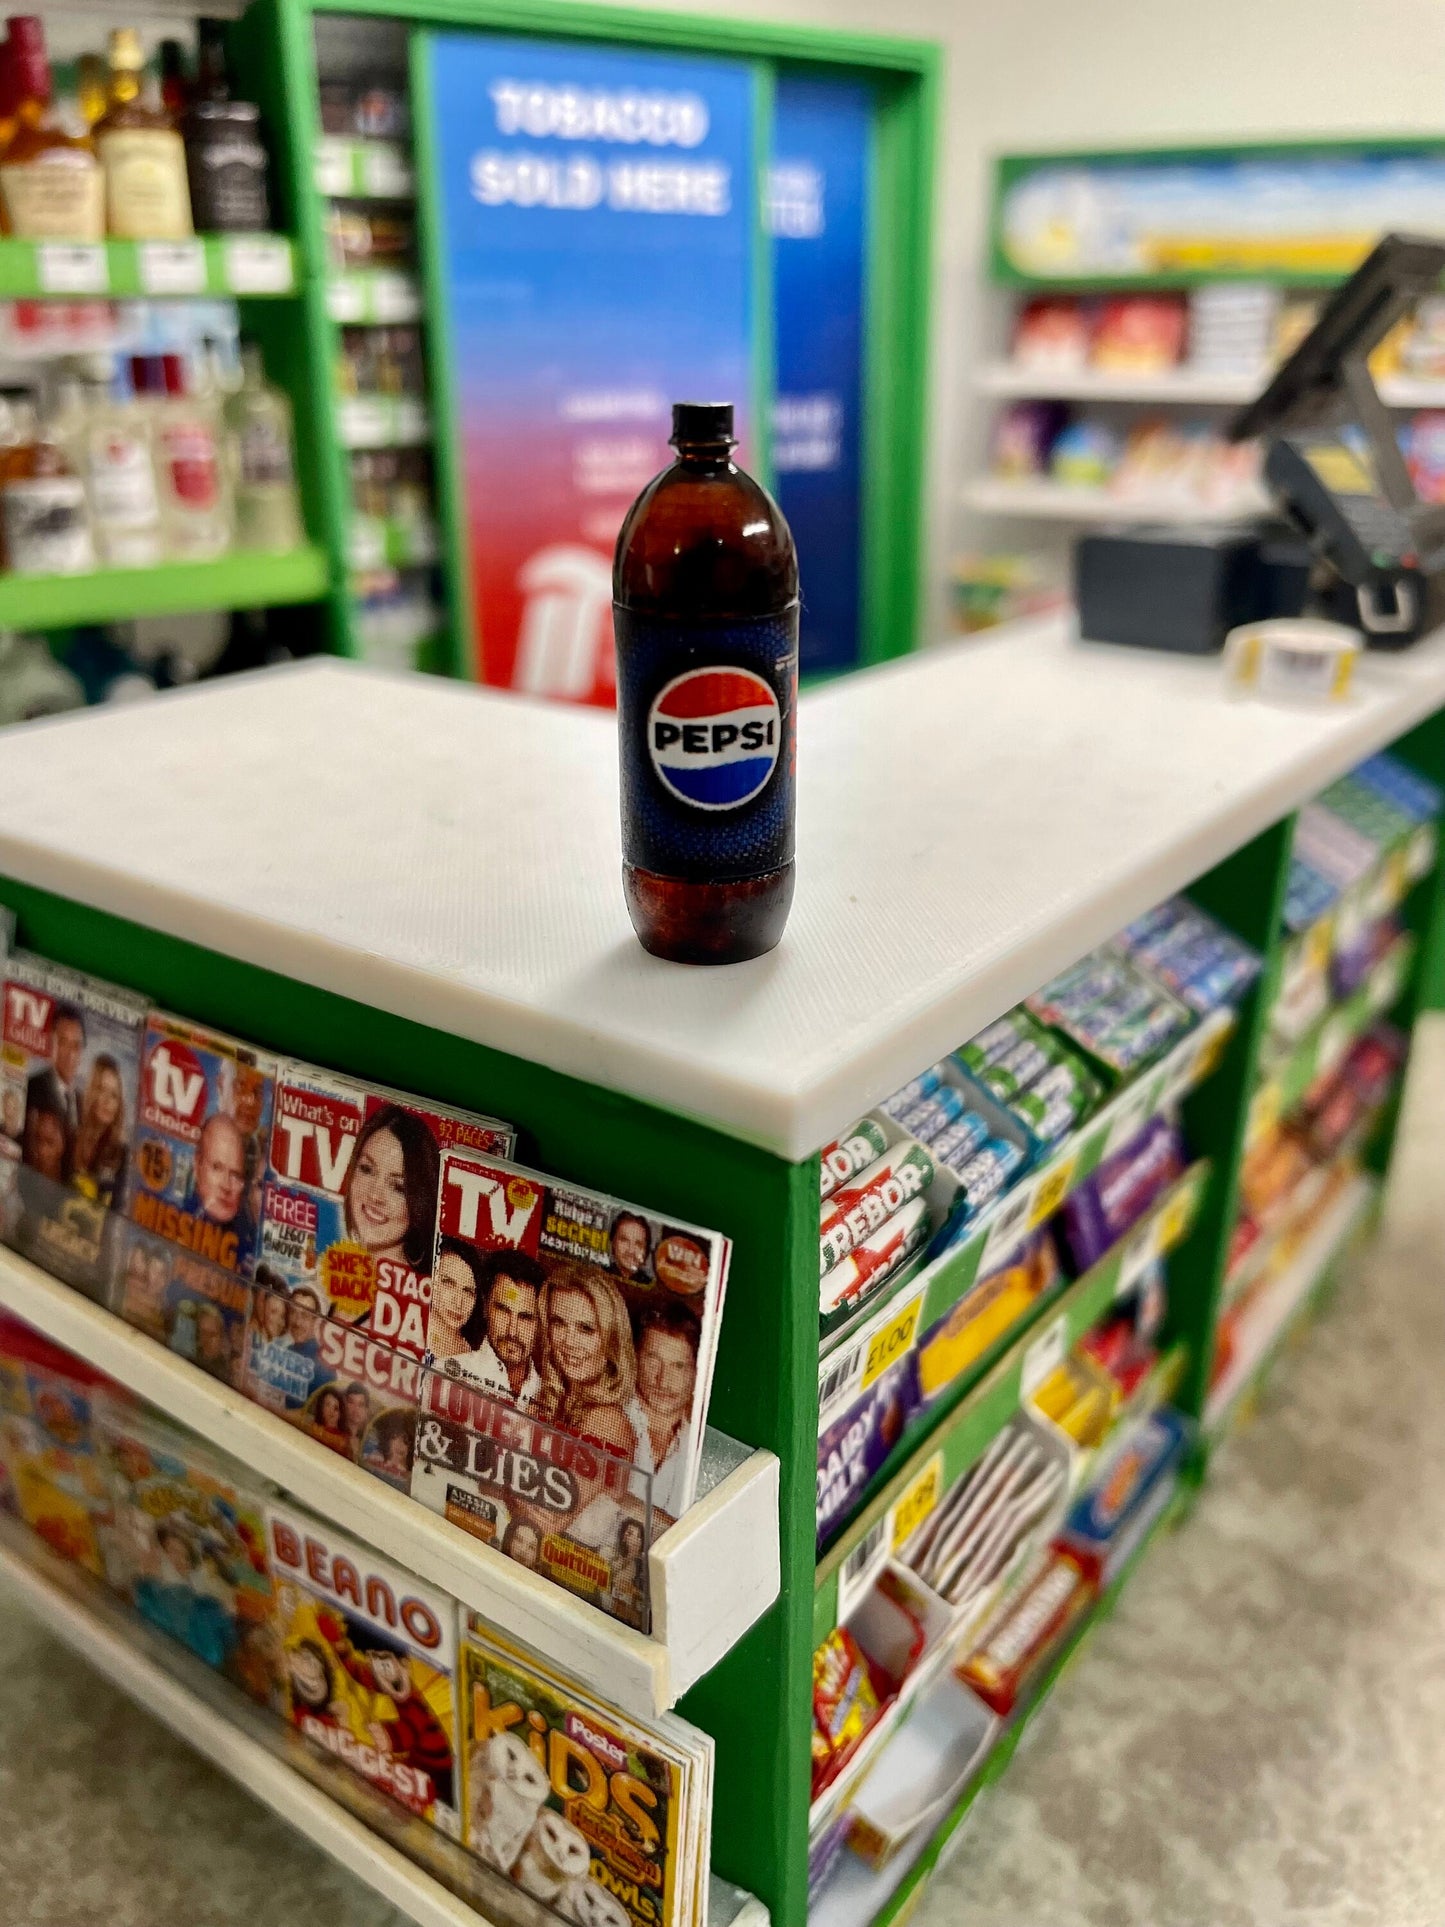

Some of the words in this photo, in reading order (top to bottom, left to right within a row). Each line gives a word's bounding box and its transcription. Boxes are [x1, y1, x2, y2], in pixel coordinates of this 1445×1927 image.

[490, 80, 710, 148] TOBACCO
[472, 150, 602, 210] SOLD
[608, 157, 732, 216] HERE
[655, 720, 774, 753] PEPSI
[9, 986, 50, 1029] TV
[282, 1090, 334, 1126] What's
[339, 1115, 361, 1134] on
[280, 1115, 357, 1193] TV
[133, 1190, 240, 1270] MISSING
[448, 1165, 539, 1245] TV
[328, 1250, 372, 1278] SHE'S
[330, 1276, 373, 1301] BACK
[866, 1315, 914, 1375] £1.00
[420, 1420, 453, 1465] &
[465, 1434, 573, 1511] LIES
[531, 1413, 629, 1487] LUST
[271, 1518, 442, 1649] BEANO
[304, 1714, 431, 1799] BIGGEST
[571, 1716, 628, 1765] Poster
